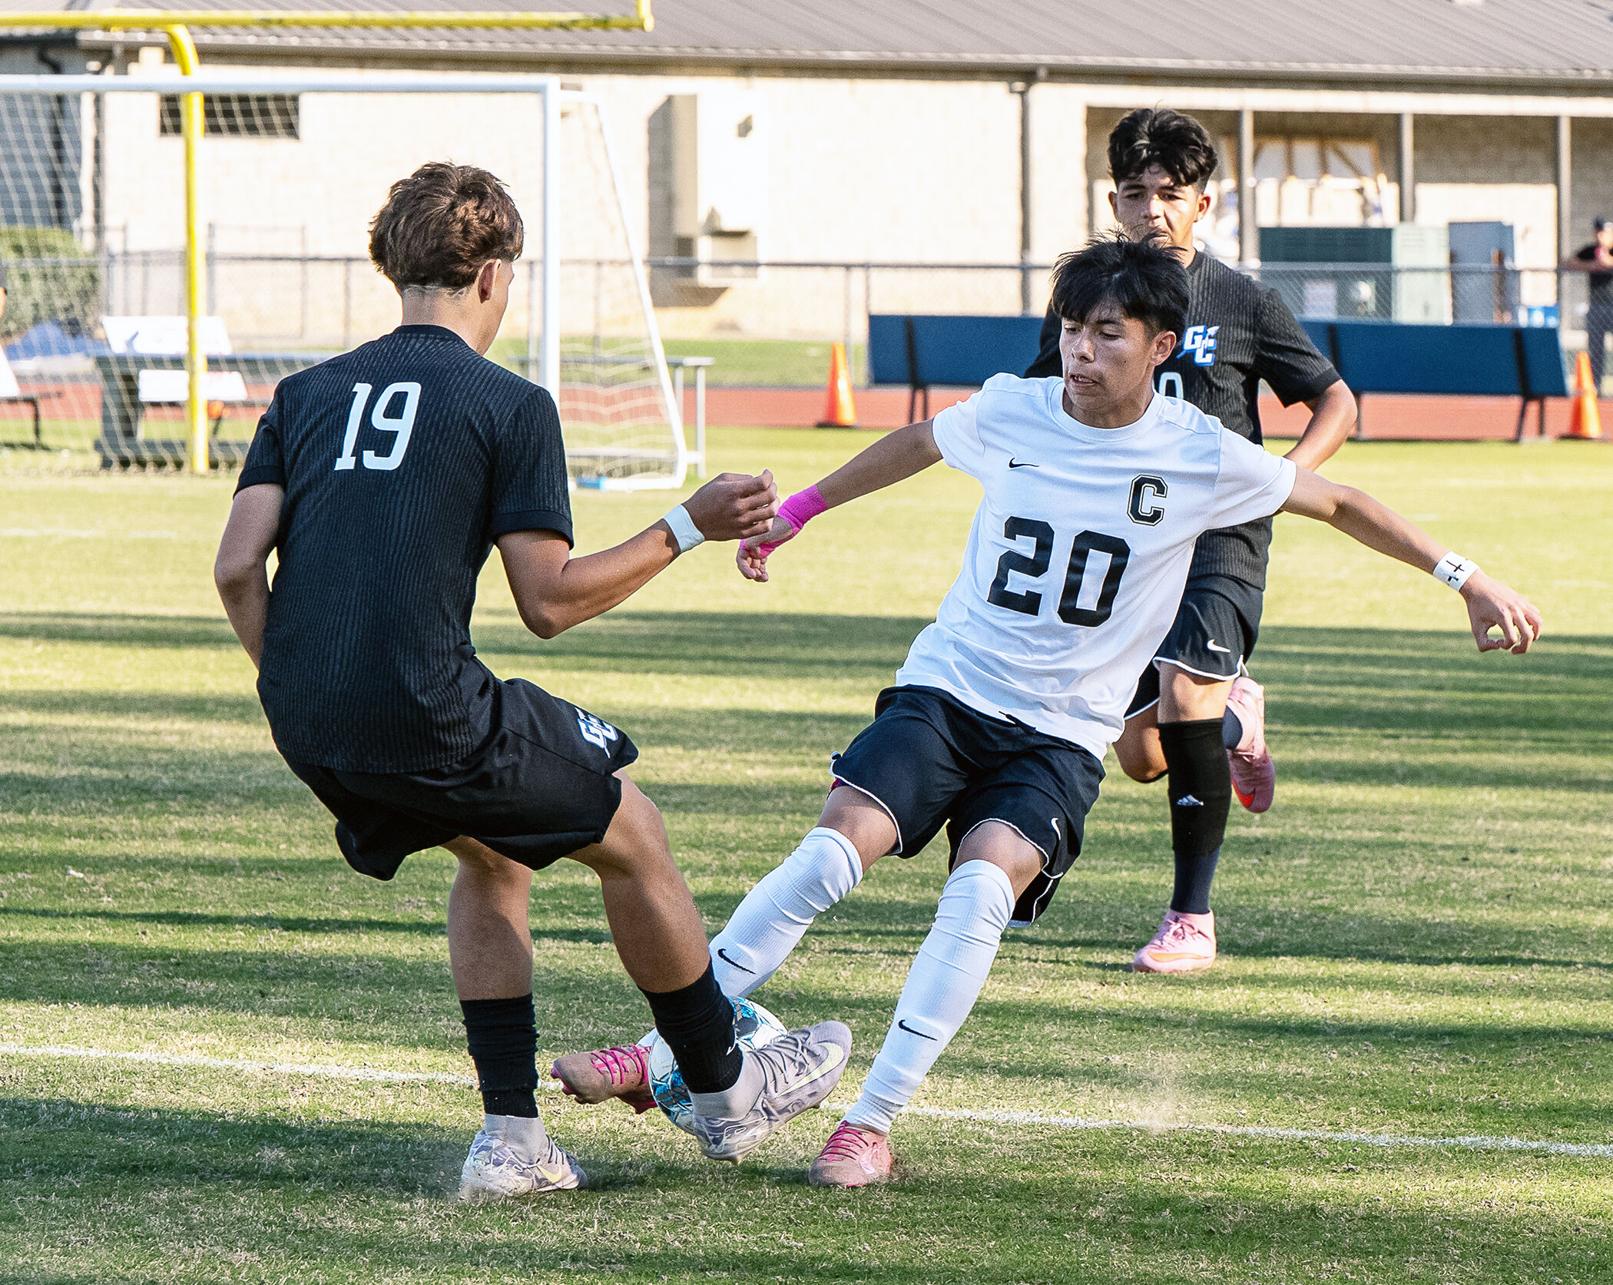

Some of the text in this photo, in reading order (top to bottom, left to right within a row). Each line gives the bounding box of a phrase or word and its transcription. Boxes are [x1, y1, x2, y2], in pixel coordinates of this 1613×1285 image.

[334, 382, 421, 471] 19
[1127, 474, 1168, 526] C
[987, 516, 1131, 627] 20
